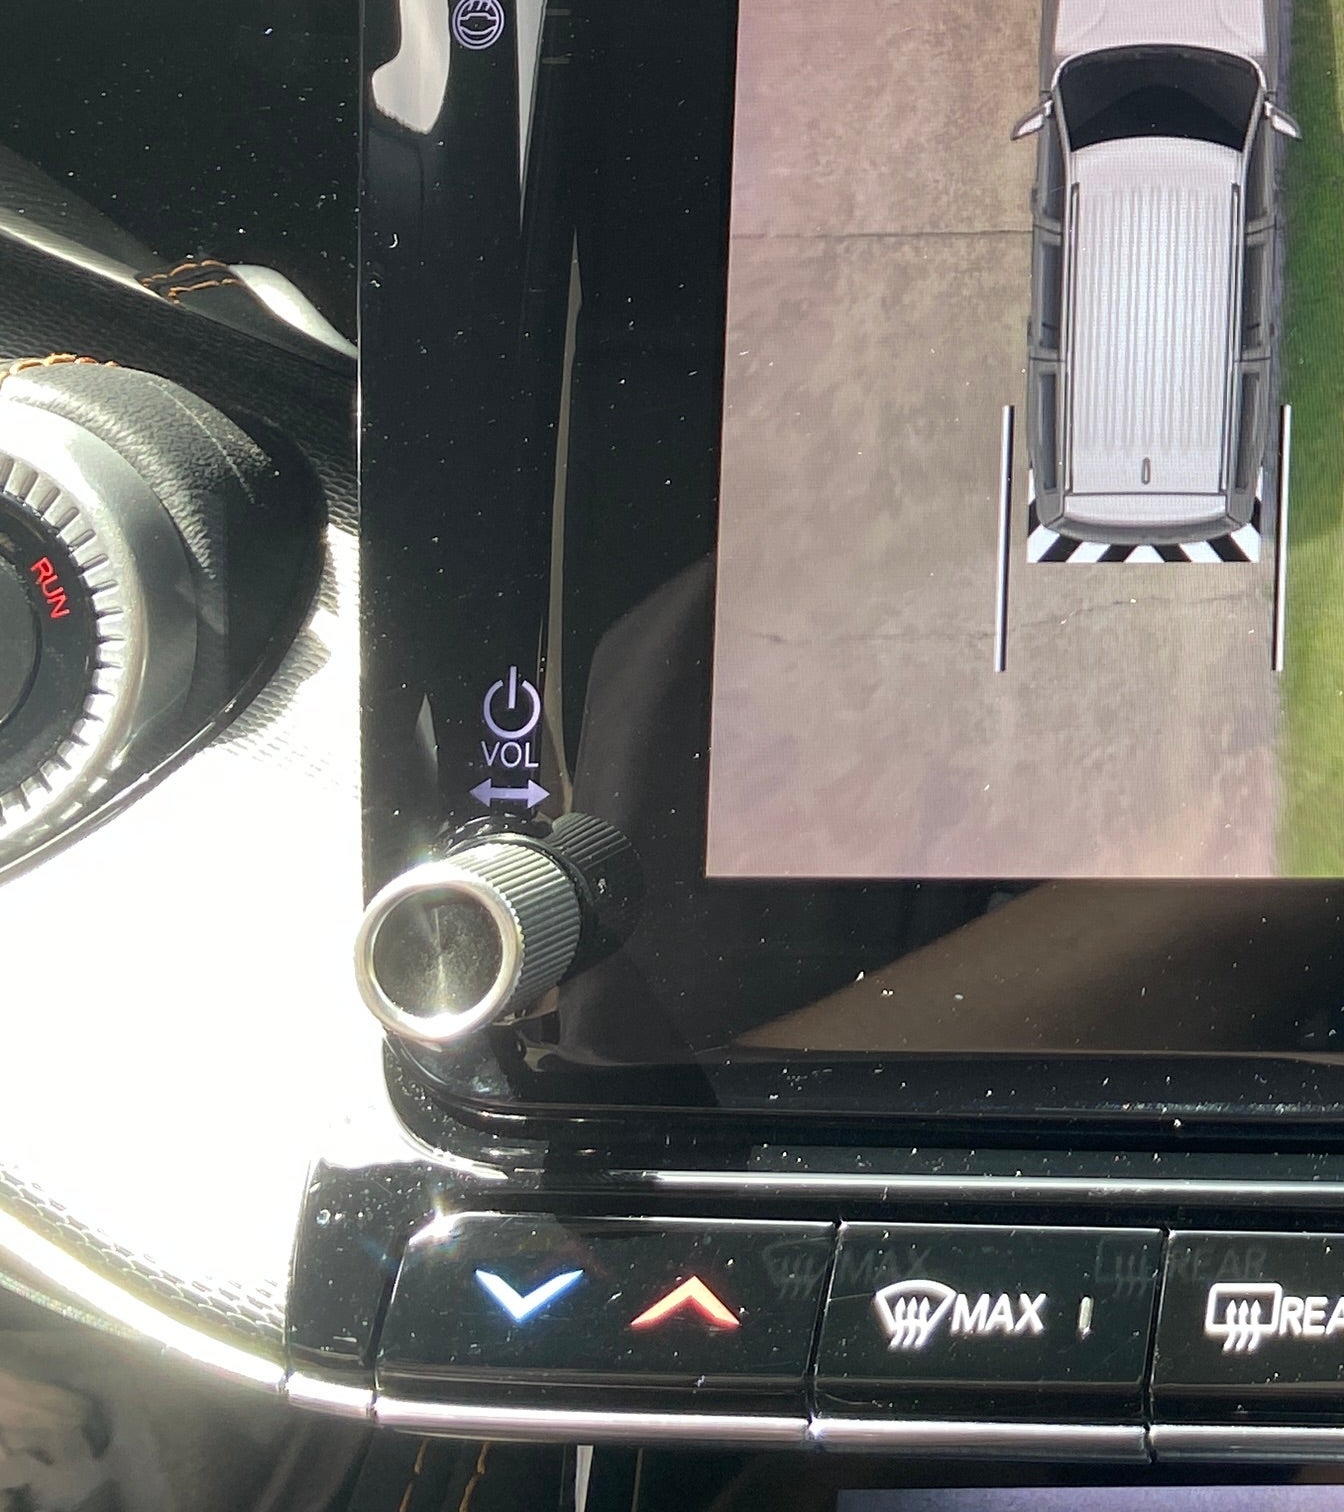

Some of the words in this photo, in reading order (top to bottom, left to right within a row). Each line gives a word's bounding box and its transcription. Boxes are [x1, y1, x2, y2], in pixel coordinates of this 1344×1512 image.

[31, 558, 70, 619] RUN
[482, 742, 538, 768] VOL
[951, 1293, 1046, 1334] MAX
